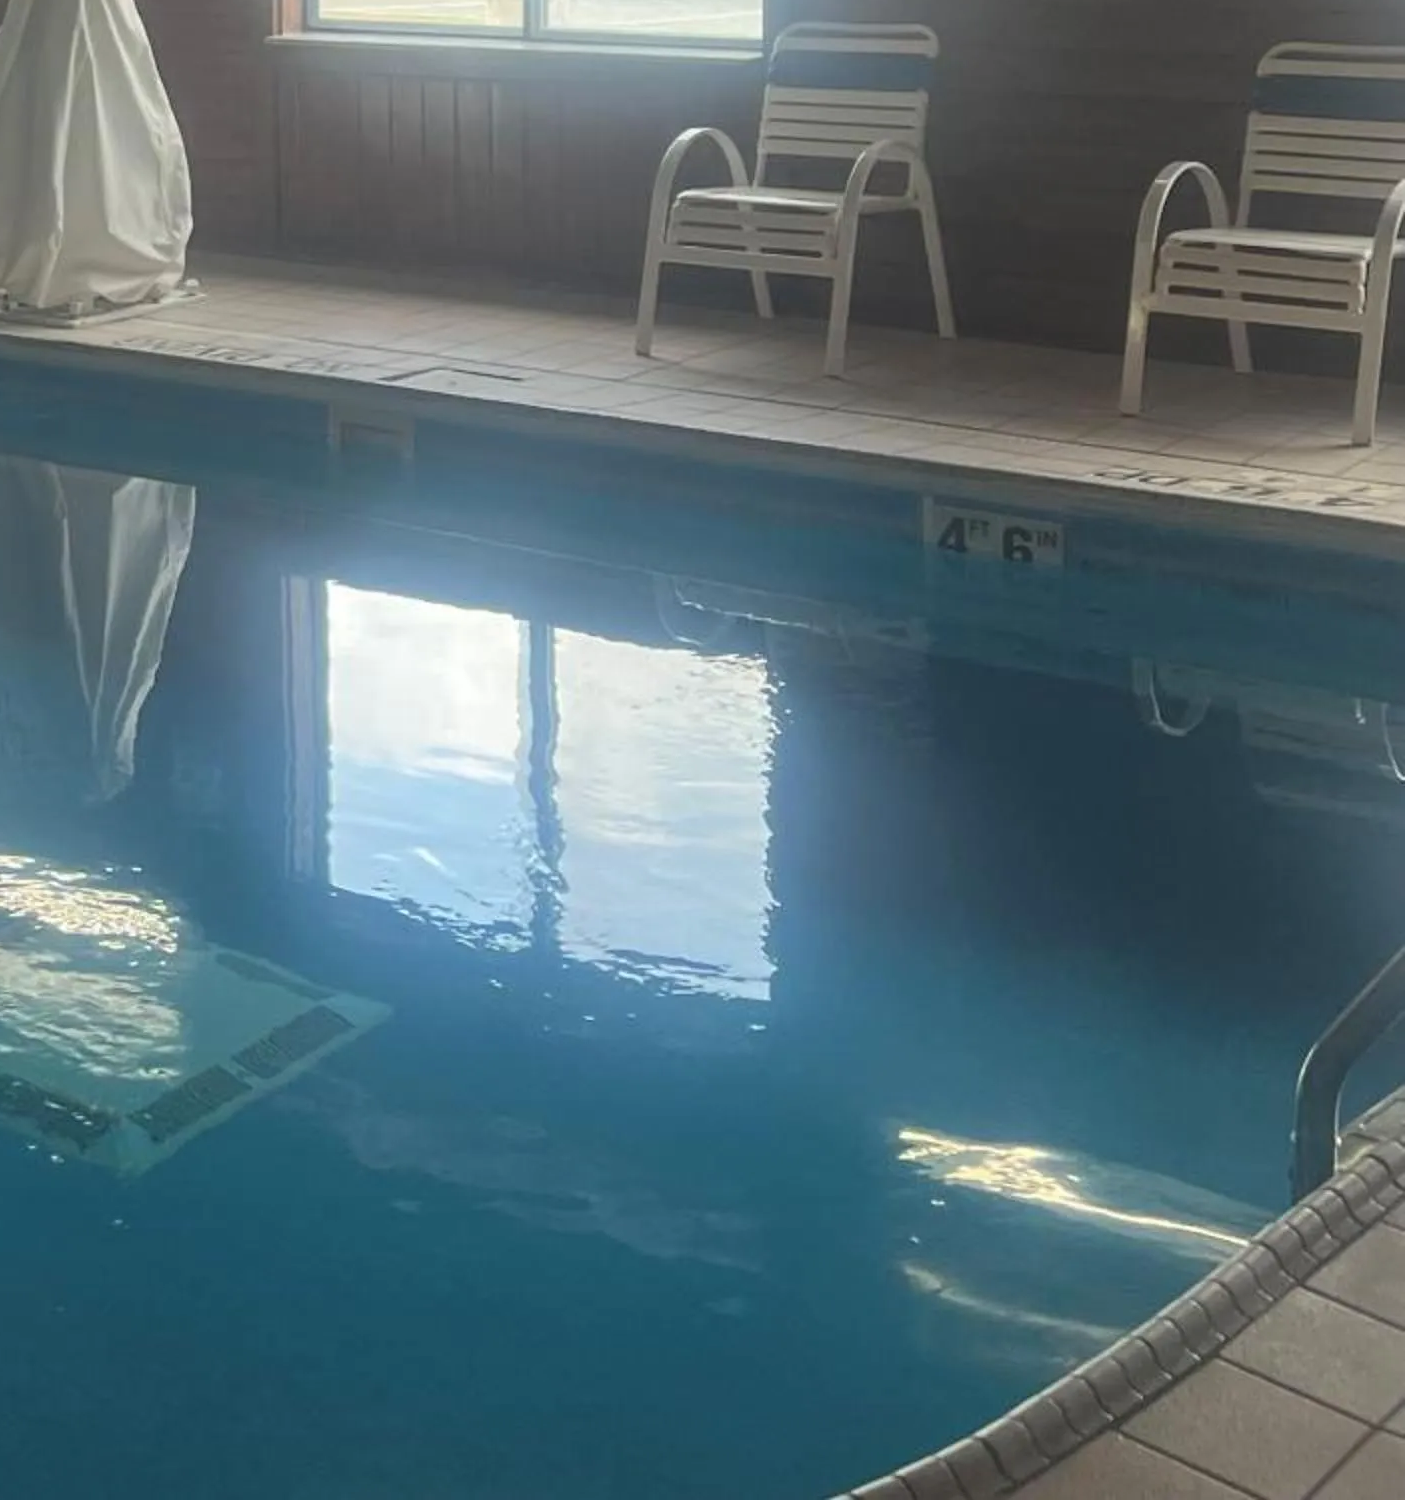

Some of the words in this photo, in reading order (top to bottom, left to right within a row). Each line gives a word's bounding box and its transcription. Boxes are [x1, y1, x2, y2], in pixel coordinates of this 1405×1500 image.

[937, 516, 968, 553] 4
[968, 519, 990, 542] FT
[1002, 525, 1034, 563] 6
[1035, 530, 1059, 550] IN
